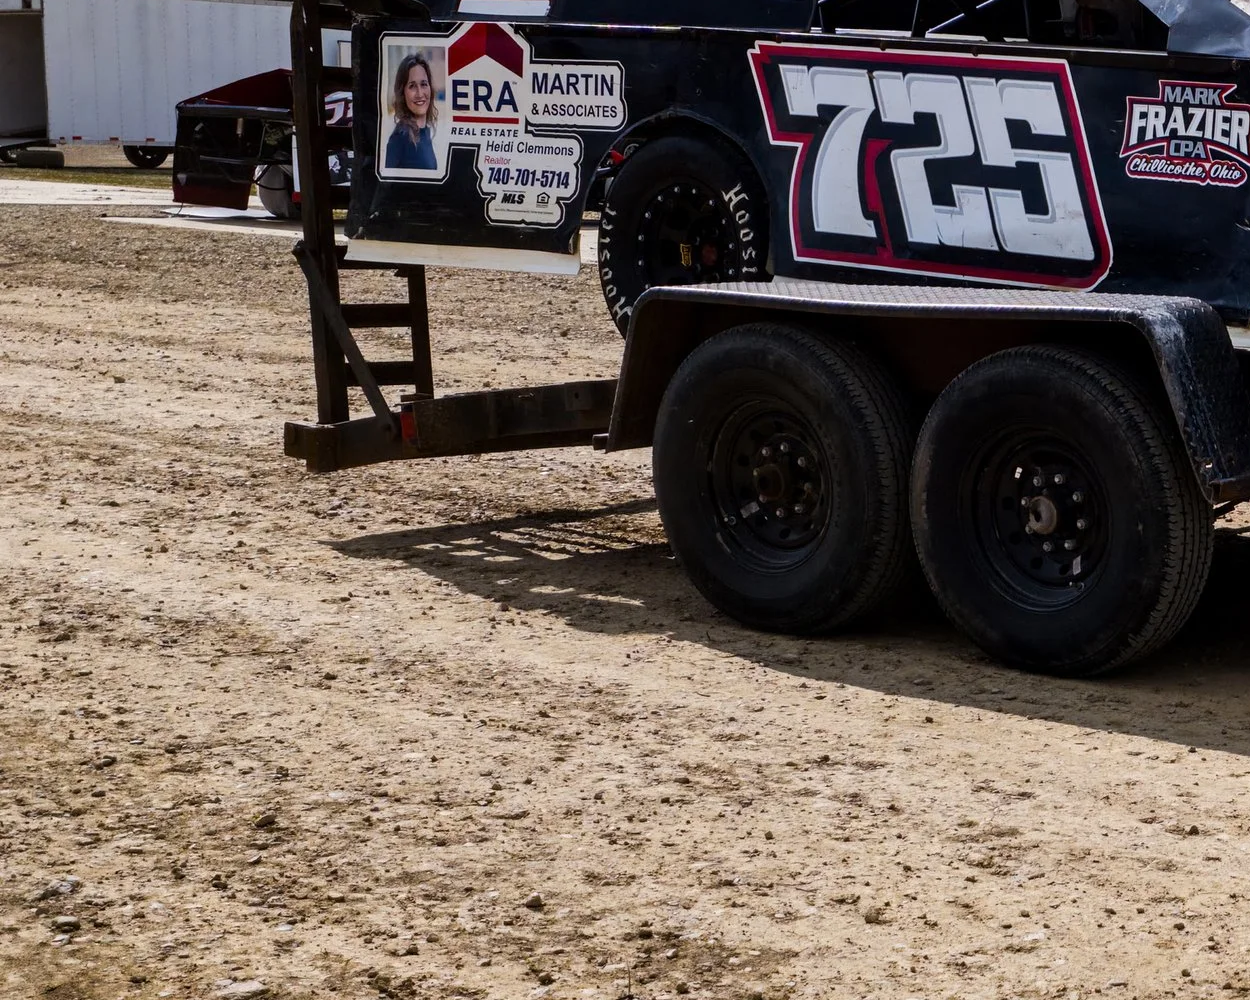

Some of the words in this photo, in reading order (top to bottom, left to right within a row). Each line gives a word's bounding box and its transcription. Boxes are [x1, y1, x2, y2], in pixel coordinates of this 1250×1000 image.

[531, 72, 615, 96] MARTIN
[451, 80, 519, 113] ERA
[1163, 85, 1222, 106] MARK
[531, 103, 540, 116] &
[542, 103, 618, 118] ASSOCIATES
[450, 127, 477, 136] REAL
[480, 128, 519, 138] ESTATE
[1128, 103, 1250, 156] FRAZIER
[485, 140, 514, 153] Heidi
[516, 141, 574, 156] Clemmons
[1169, 139, 1207, 159] CPA
[483, 155, 511, 165] Realtor
[778, 64, 1096, 261] 725
[1129, 157, 1206, 179] Chillicothe,
[1210, 163, 1242, 180] Ohio
[487, 167, 570, 189] 740-701-5714
[500, 193, 526, 205] MLS
[720, 181, 758, 274] Hoosi
